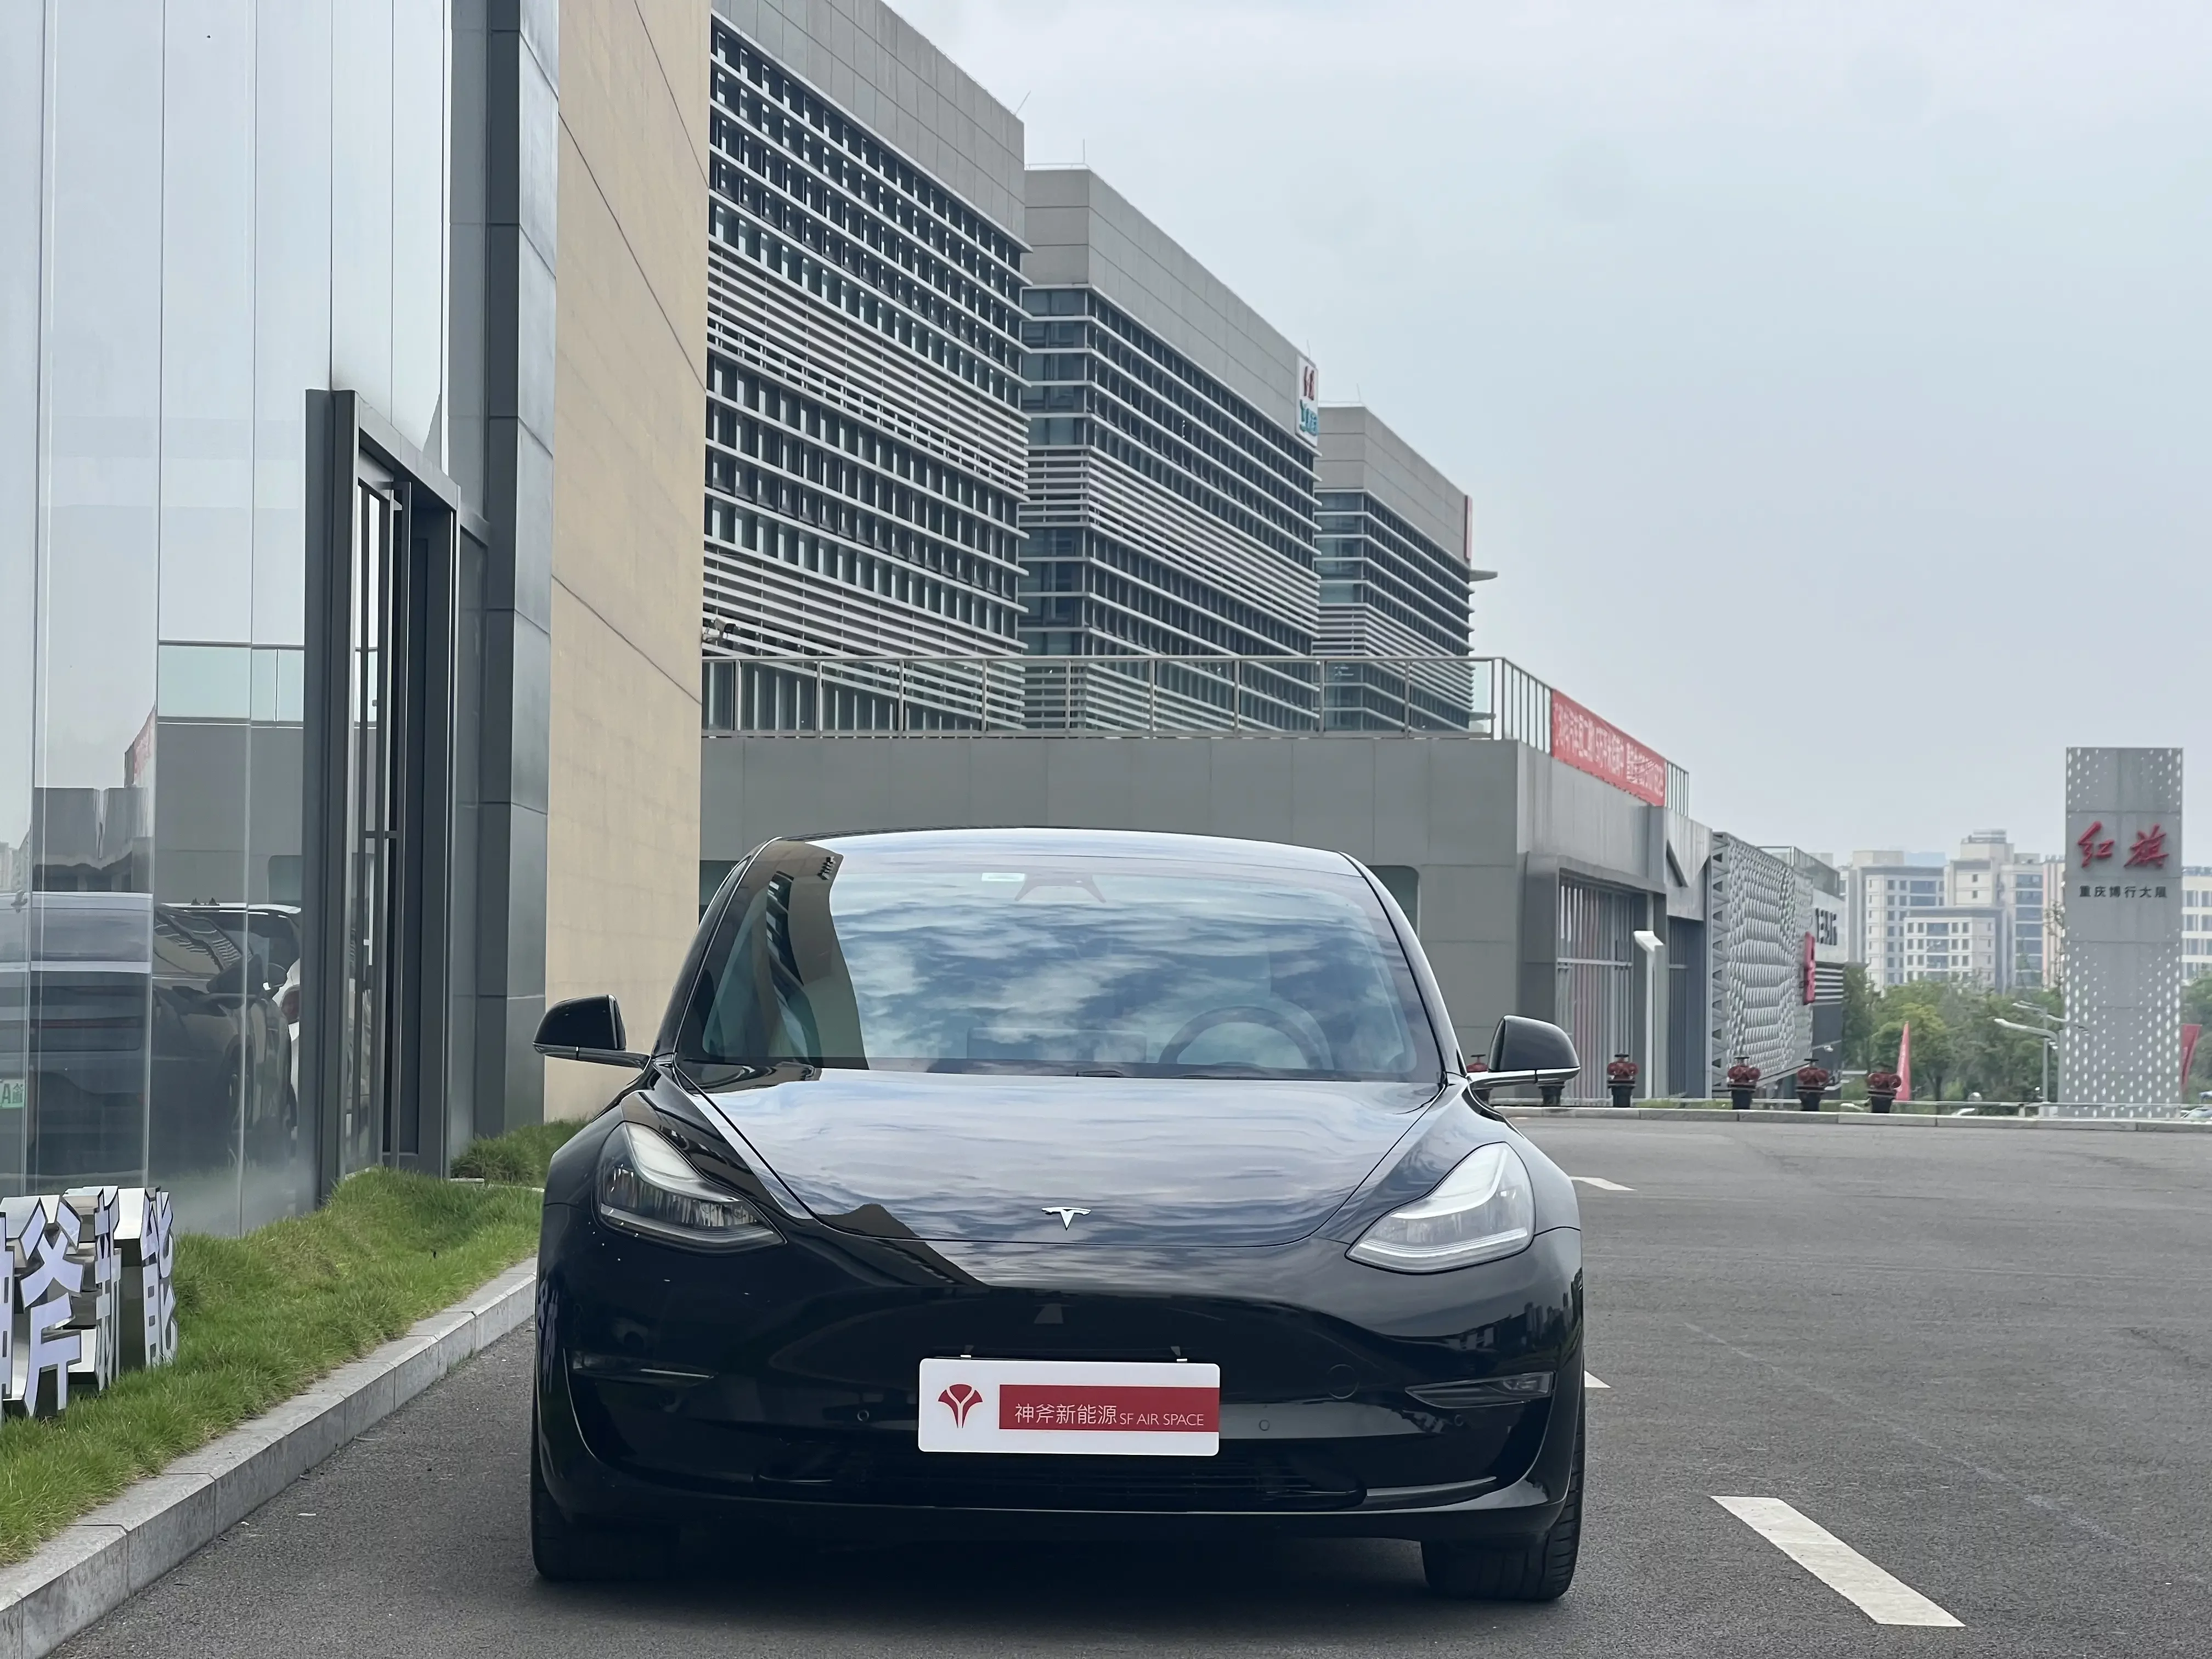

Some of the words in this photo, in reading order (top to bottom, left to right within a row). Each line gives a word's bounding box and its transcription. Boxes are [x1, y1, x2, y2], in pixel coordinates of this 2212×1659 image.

[1014, 1403, 1117, 1425] 神斧新能源
[1119, 1413, 1134, 1425] SF
[1136, 1413, 1160, 1426] AIR
[1163, 1413, 1205, 1426] SPACE
